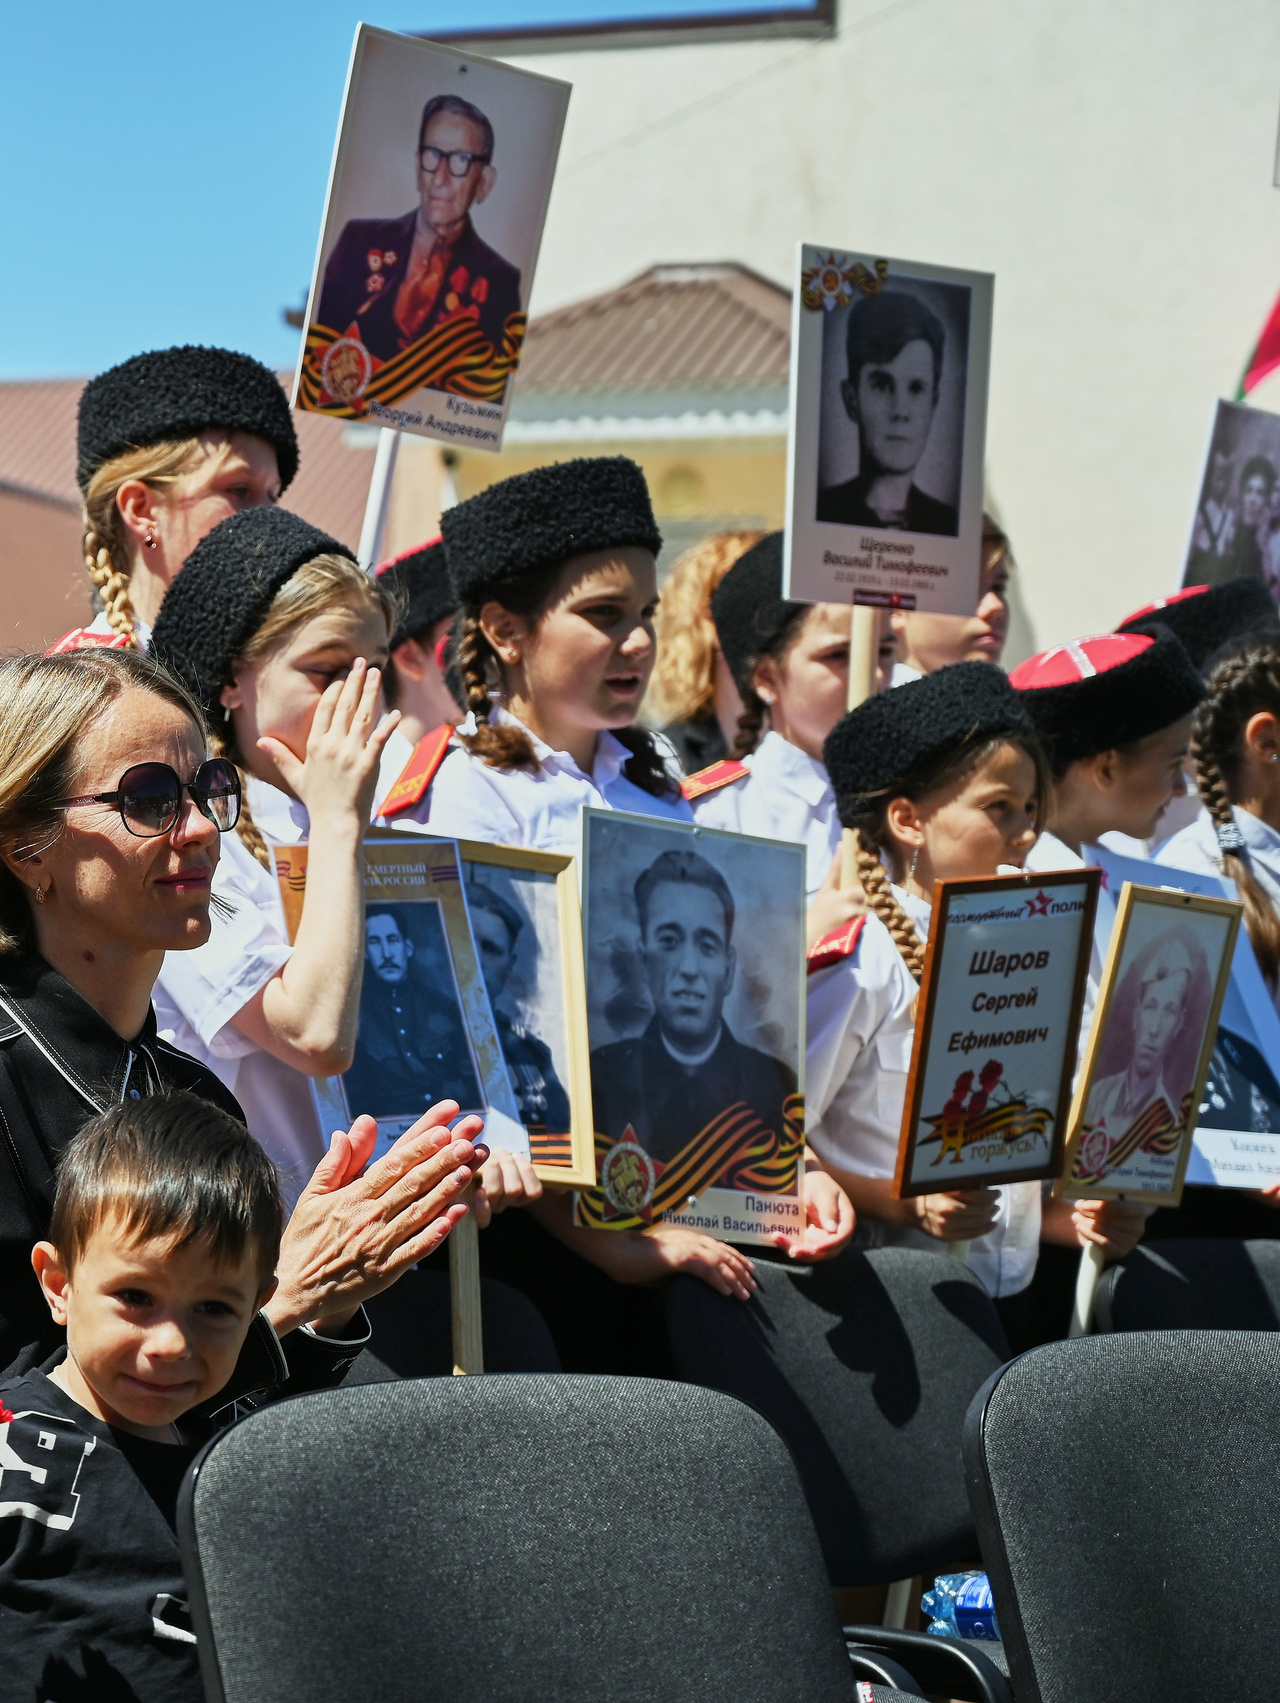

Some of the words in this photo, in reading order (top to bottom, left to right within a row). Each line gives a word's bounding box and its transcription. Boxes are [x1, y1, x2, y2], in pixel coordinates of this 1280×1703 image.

[446, 394, 503, 422] Кузьмин
[424, 415, 499, 444] Андреевич
[823, 549, 873, 571] Василий
[876, 556, 949, 578] Тимофеевич
[366, 862, 427, 874] СМЕРТНЫЙ
[383, 875, 426, 886] РОССИИ
[946, 905, 1027, 925] ессмертный
[968, 949, 1050, 978] Шаров
[972, 986, 1038, 1015] Сергей
[947, 1025, 1049, 1055] Ефимович
[745, 1195, 800, 1217] Панюта
[663, 1207, 719, 1229] Николай
[723, 1218, 800, 1237] Васильевич
